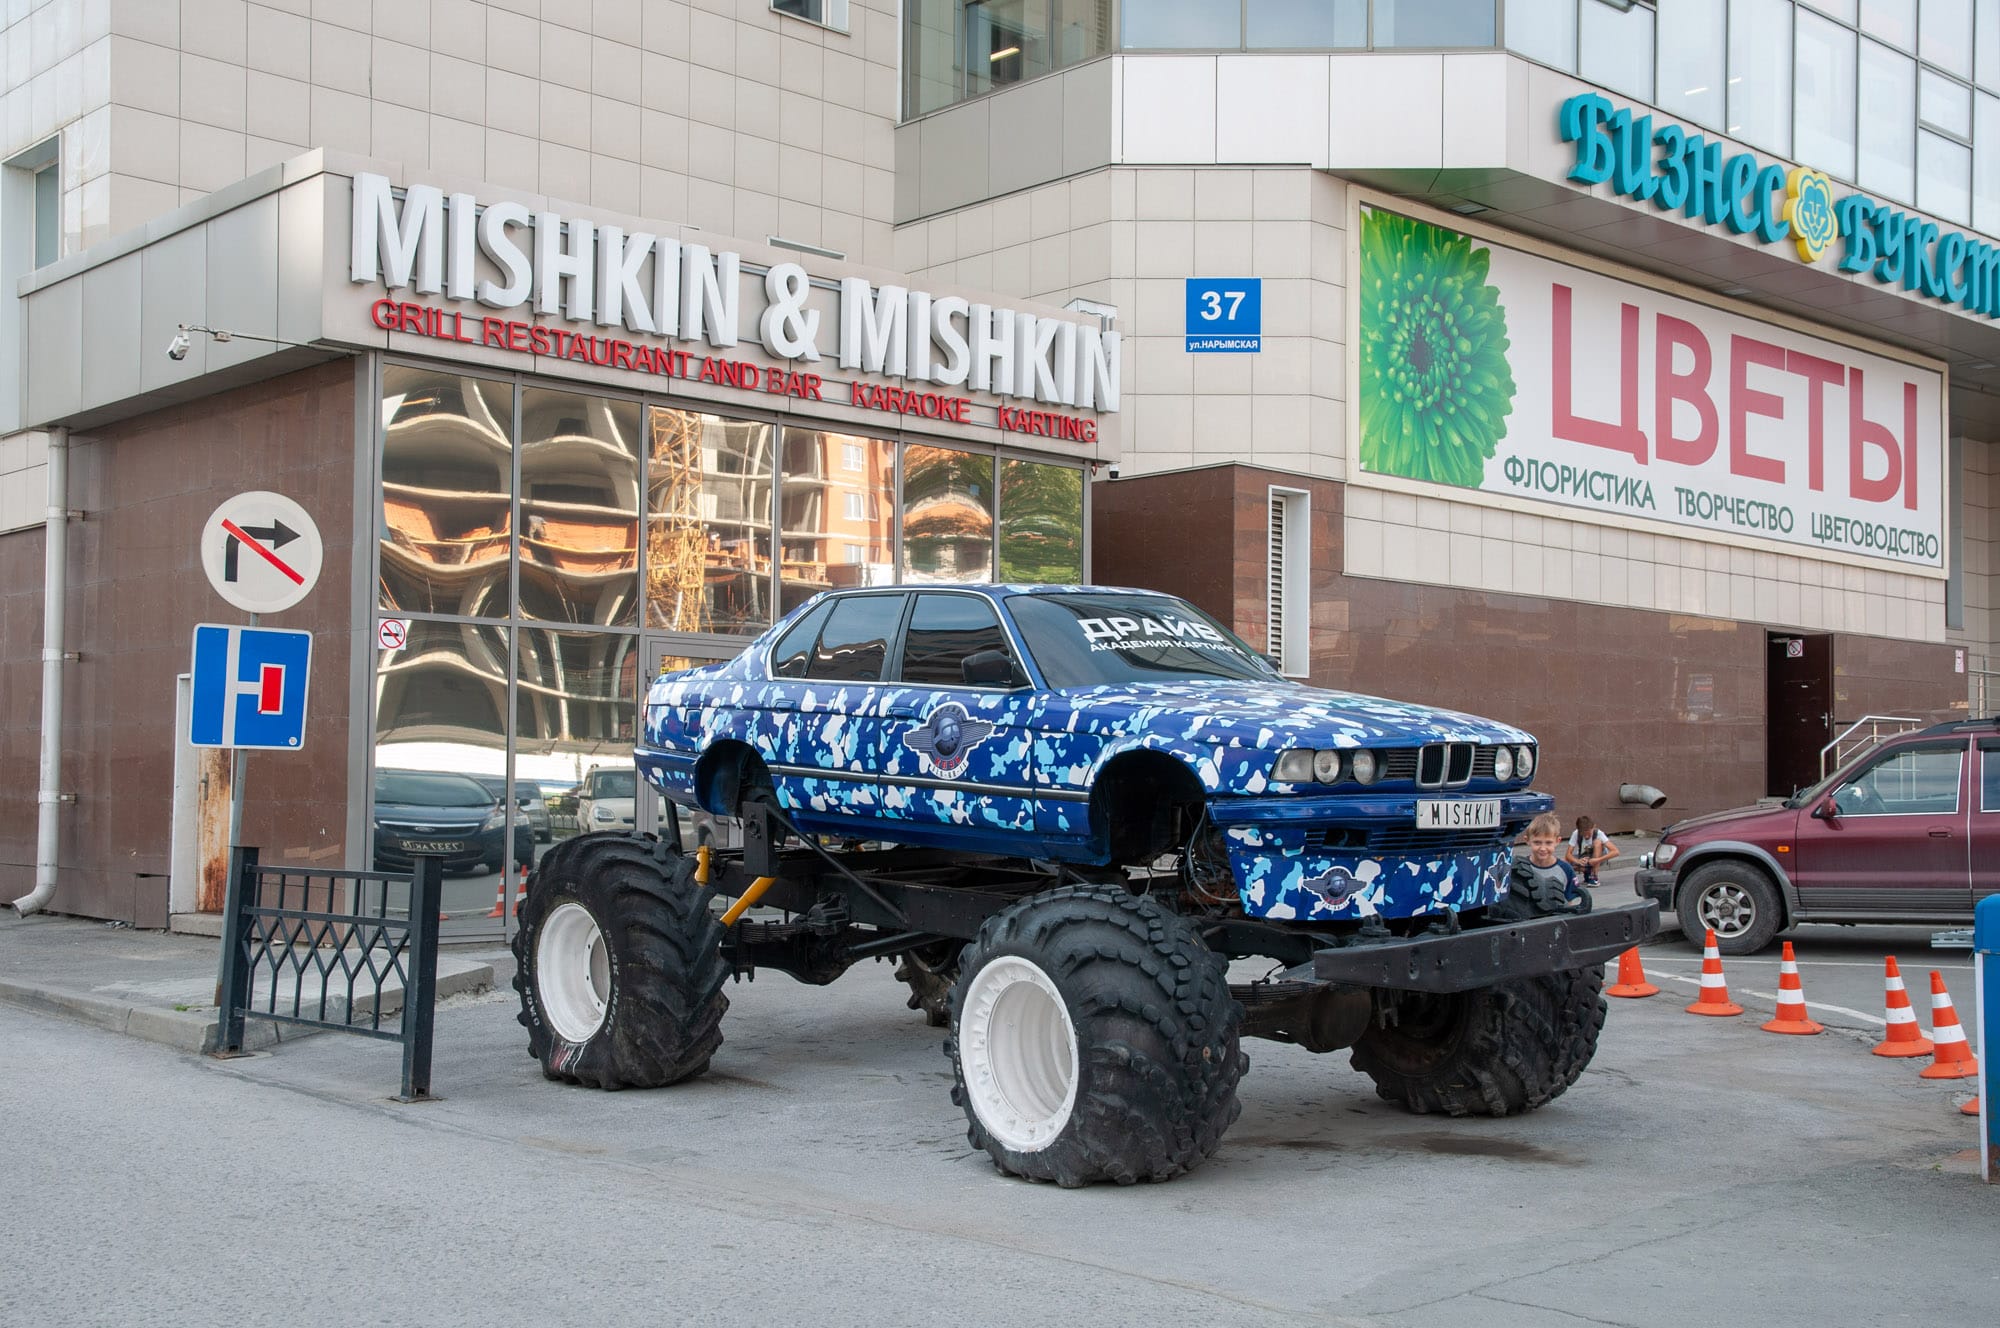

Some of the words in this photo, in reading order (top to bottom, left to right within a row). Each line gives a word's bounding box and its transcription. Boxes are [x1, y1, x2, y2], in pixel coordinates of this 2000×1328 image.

[1560, 92, 1789, 244] Бизнес
[352, 171, 740, 348] MISHKIN
[760, 262, 821, 363] &
[840, 276, 1121, 413] MISHKIN
[1200, 291, 1246, 320] 37
[371, 299, 473, 343] GRILL
[483, 317, 694, 379] RESTAURANT
[699, 357, 759, 390] AND
[767, 367, 822, 400] BAR
[852, 381, 971, 423] KARAOKE
[998, 405, 1097, 442] KARTING
[1552, 283, 1917, 510] ЦВЕТЫ
[1503, 455, 1656, 510] ФЛОРИСТИКА
[1675, 486, 1794, 534] ТВОРЧЕСТВО
[1811, 512, 1938, 559] ЦВЕТОВОДСТВО
[1077, 615, 1224, 643] ДРАЙВ
[1090, 639, 1173, 652] АКАДЕМИЯ
[1431, 803, 1494, 825] MISHKIN
